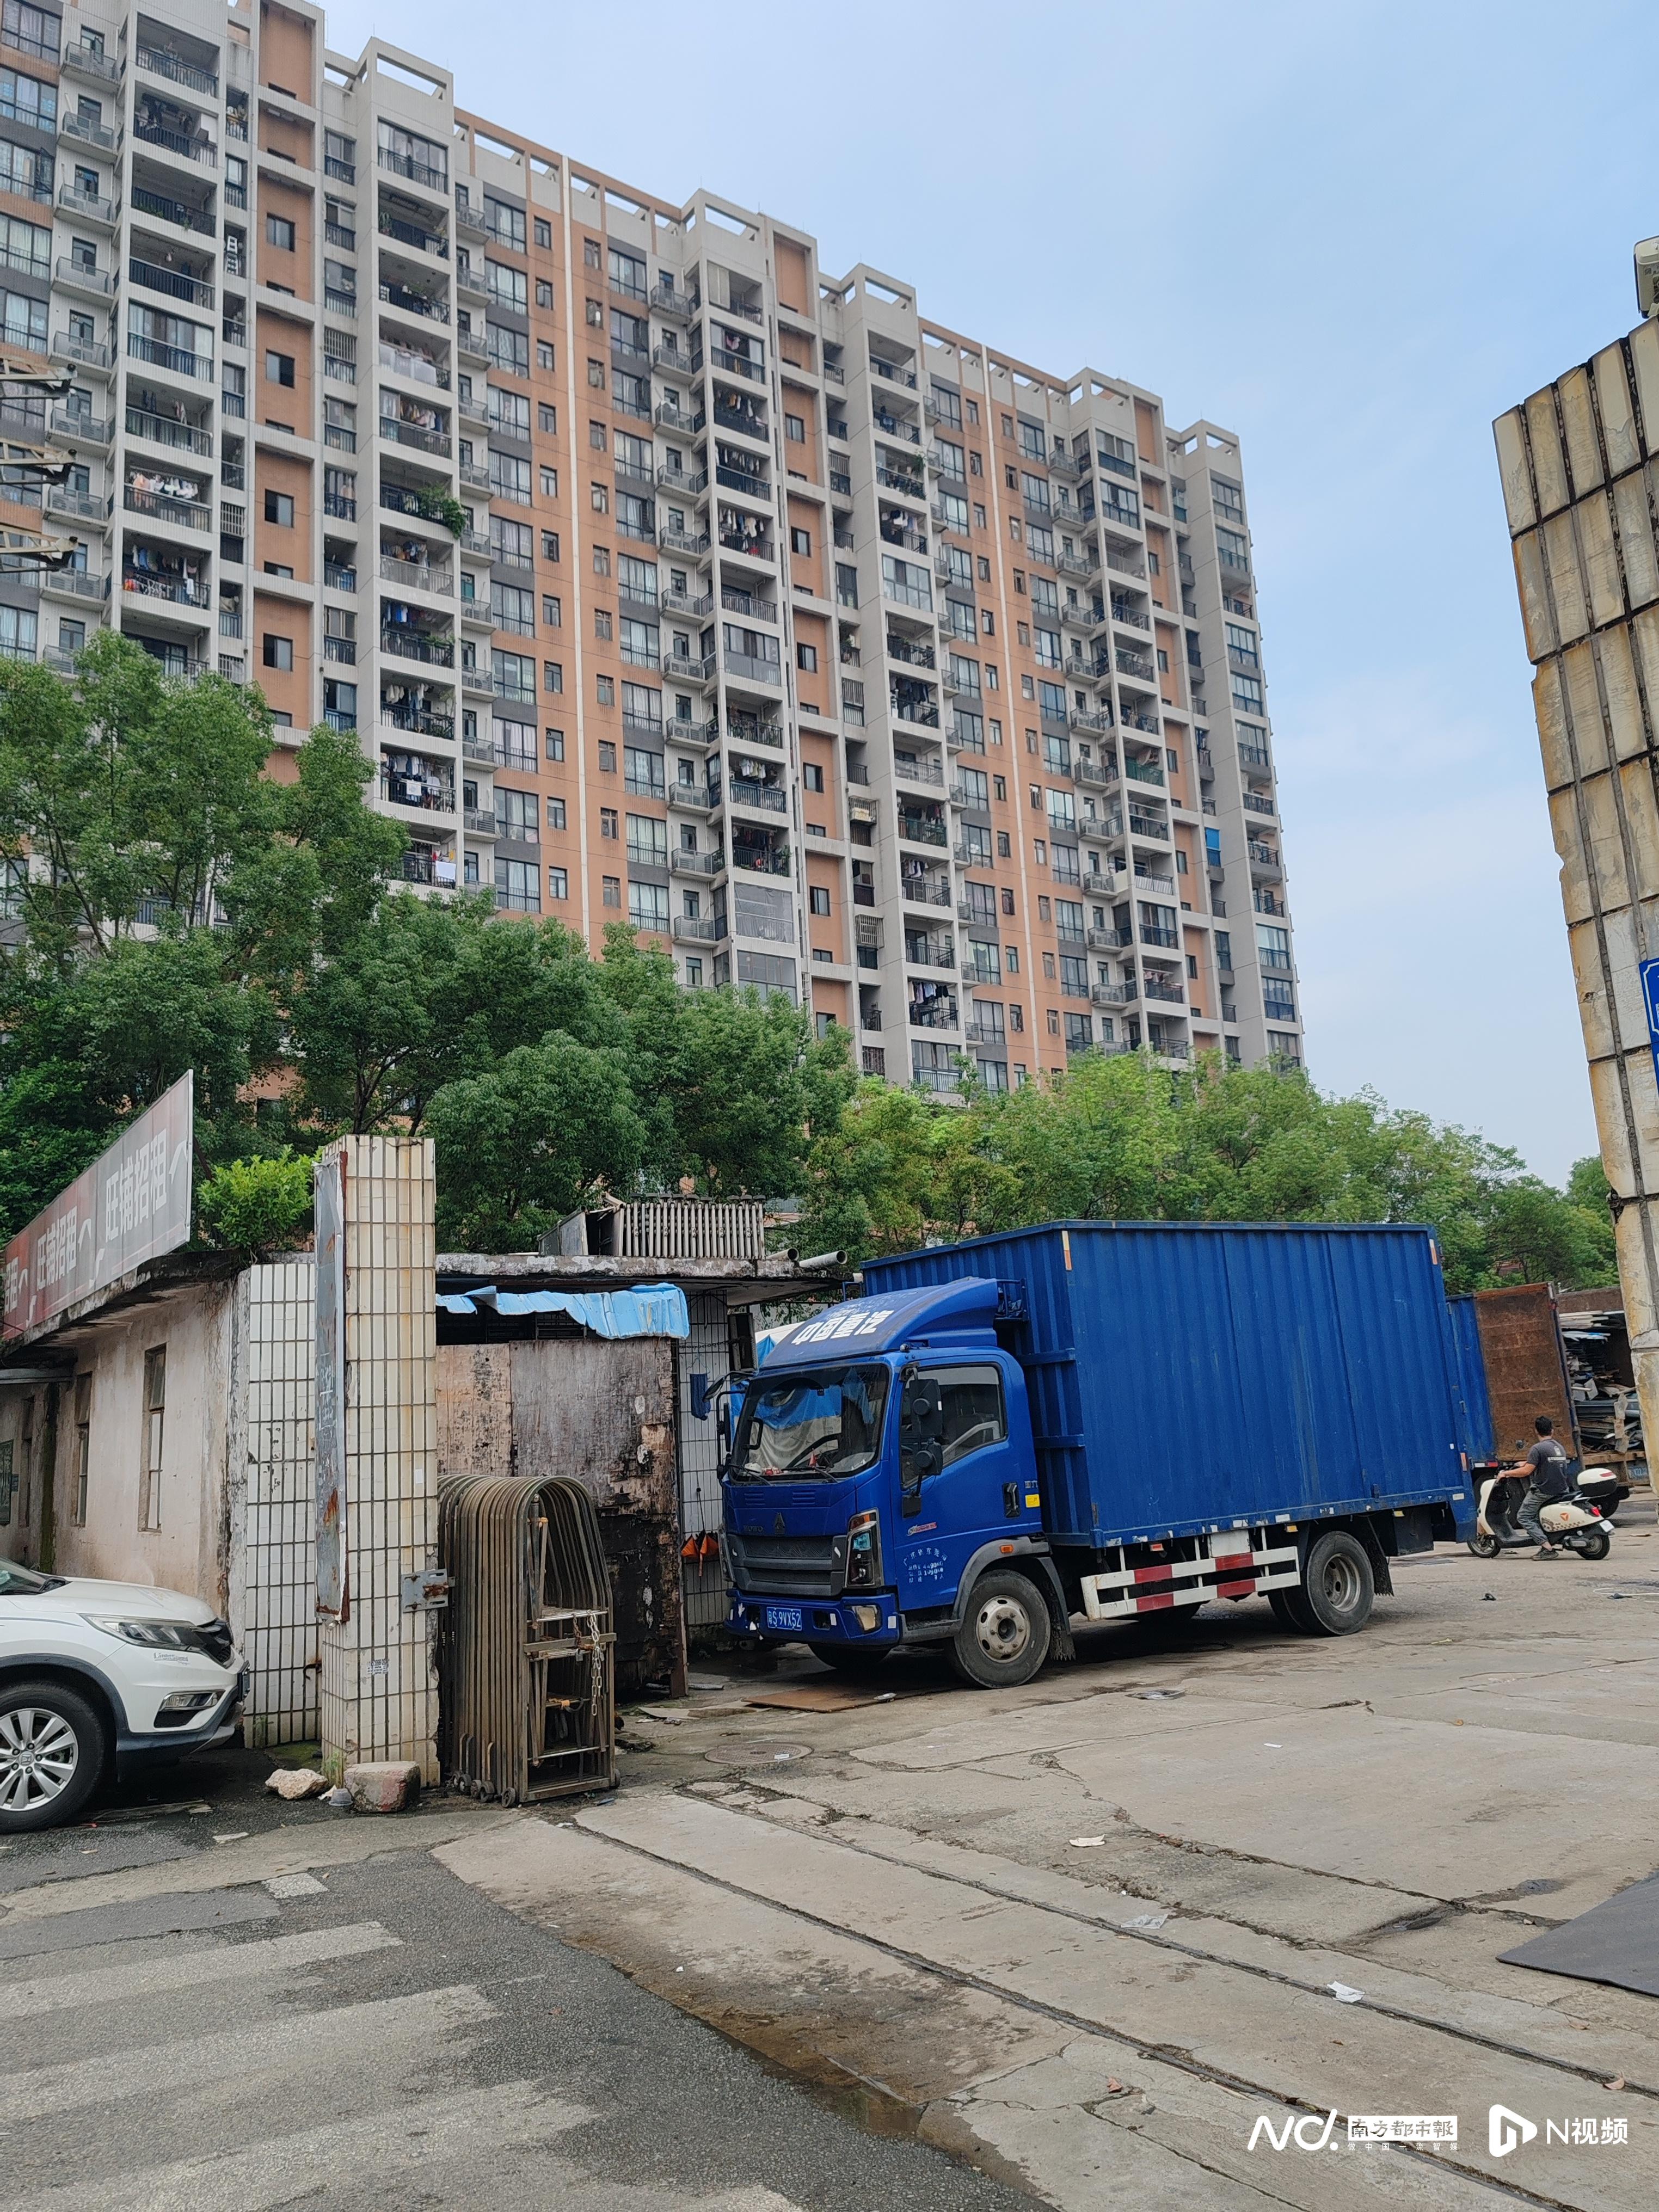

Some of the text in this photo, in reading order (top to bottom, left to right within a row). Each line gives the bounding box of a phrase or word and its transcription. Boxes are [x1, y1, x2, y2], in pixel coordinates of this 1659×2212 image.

[106, 1127, 167, 1243] 旺铺招租
[36, 1206, 77, 1292] 旺铺招租
[791, 1310, 895, 1345] 中国重汽
